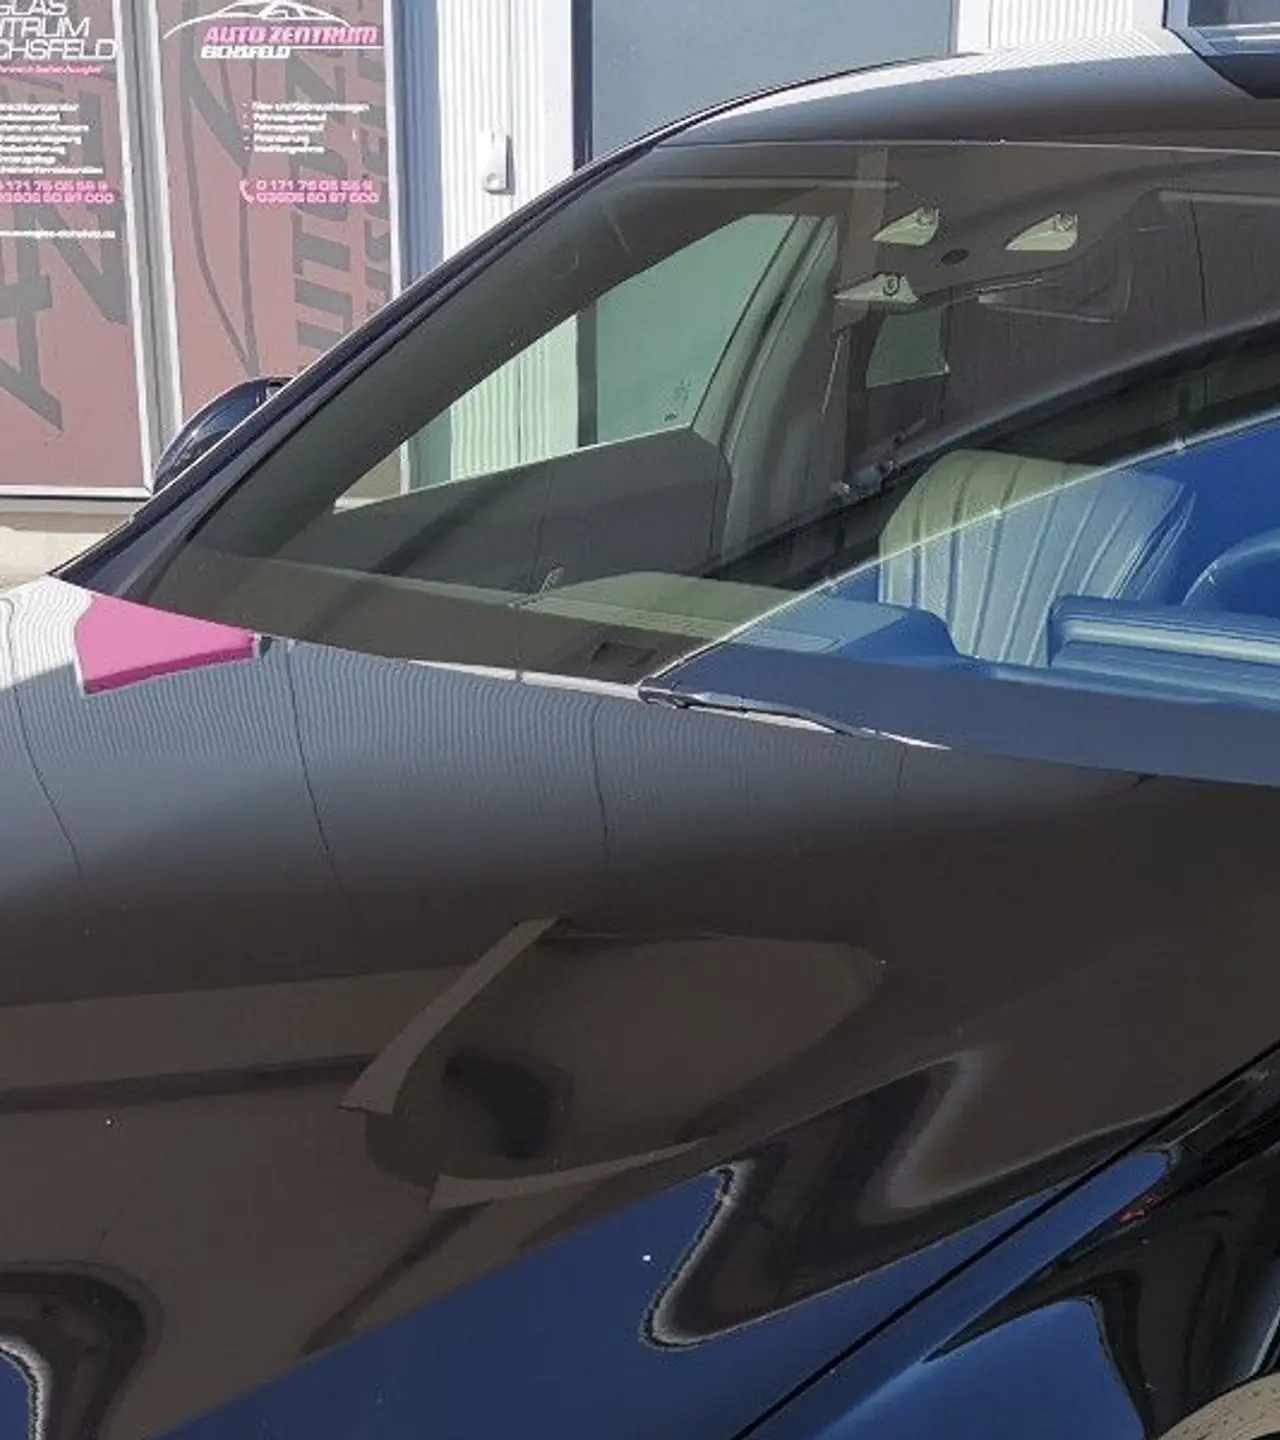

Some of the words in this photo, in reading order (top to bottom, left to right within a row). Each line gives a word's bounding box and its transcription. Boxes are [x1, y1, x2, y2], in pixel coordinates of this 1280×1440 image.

[204, 25, 265, 44] AUTO
[268, 25, 377, 44] ZENTRUM
[200, 46, 291, 59] EICHSFELD
[269, 180, 295, 191] 171
